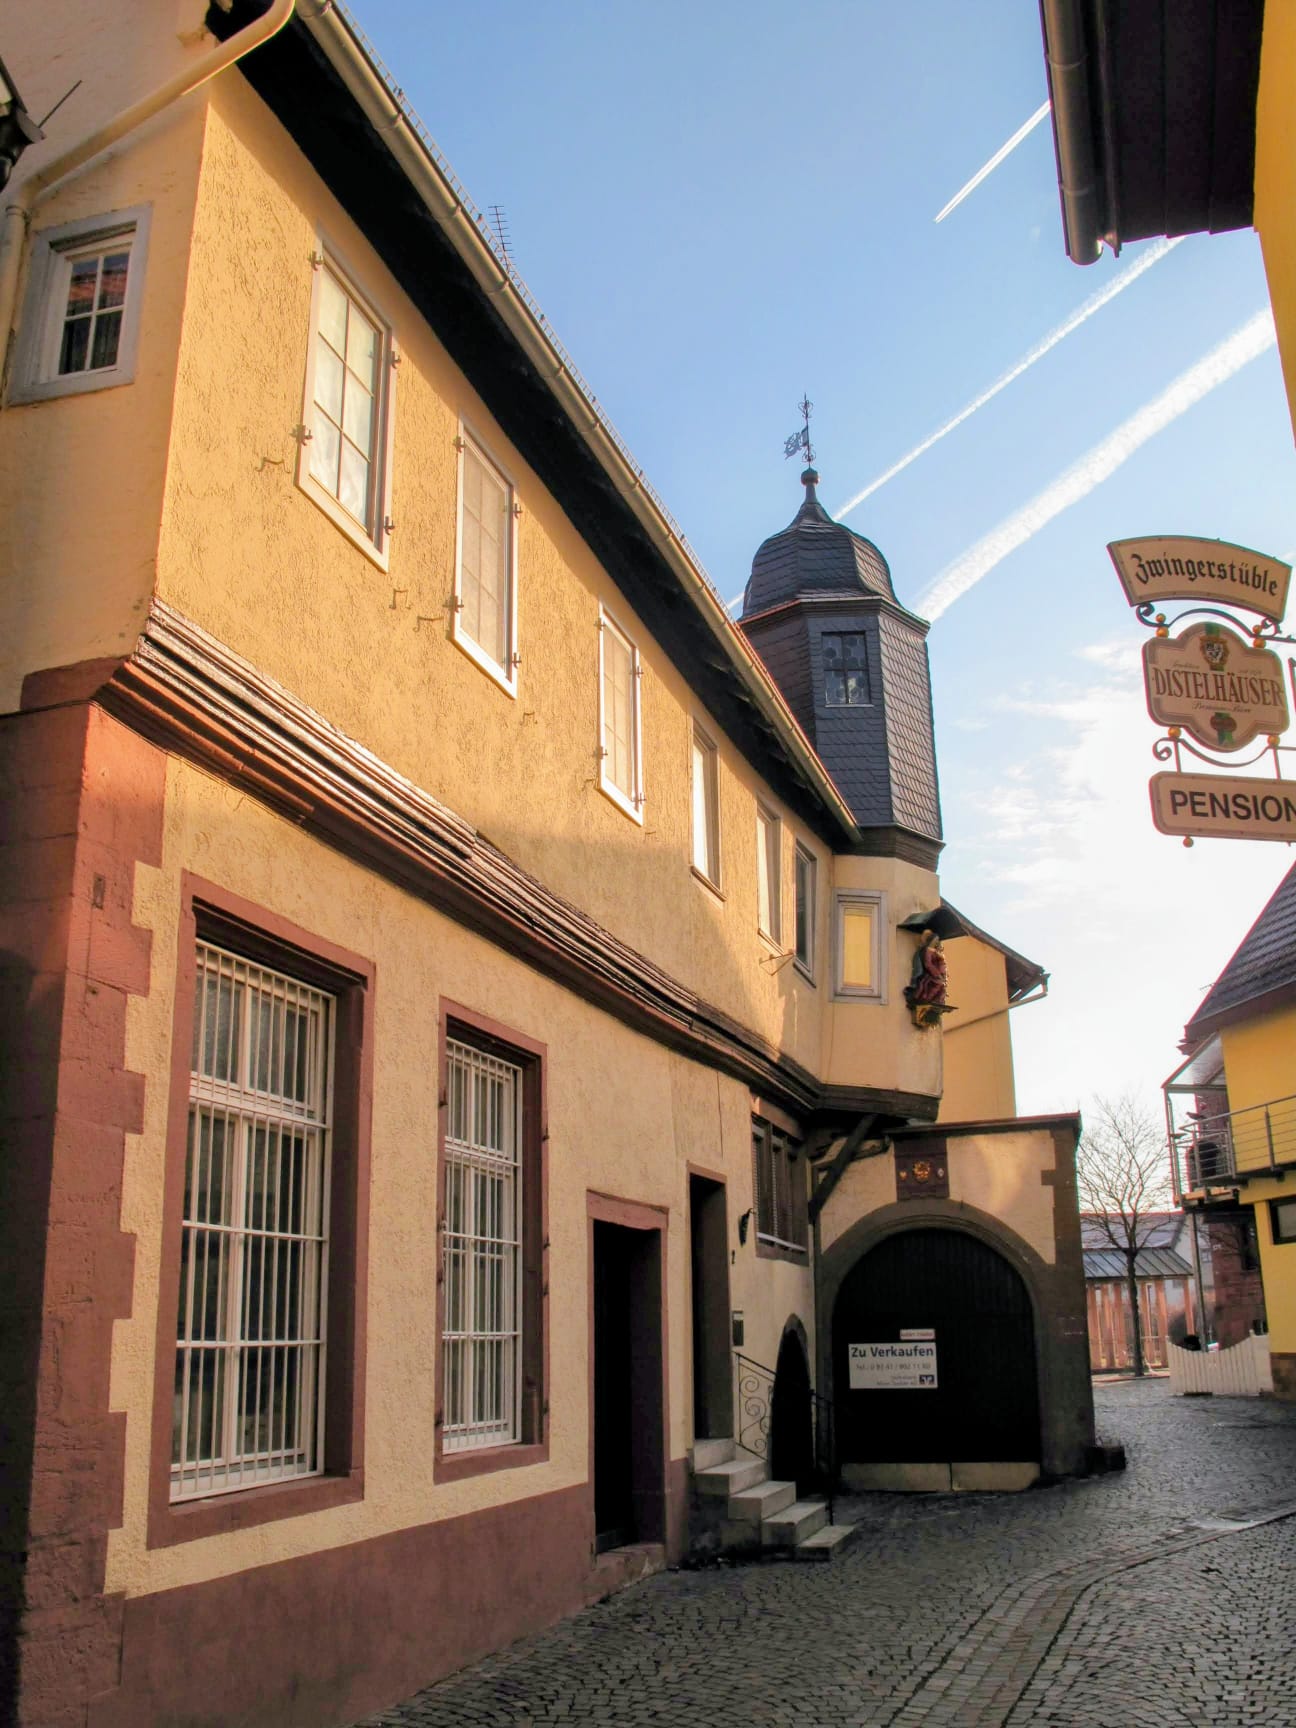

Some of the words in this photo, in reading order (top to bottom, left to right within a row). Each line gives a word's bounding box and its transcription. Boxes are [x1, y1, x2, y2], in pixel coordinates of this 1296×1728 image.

[1131, 552, 1279, 597] Zwingerstüble
[1153, 668, 1283, 706] DISTELHÄUSER
[1170, 789, 1296, 822] PENSION
[851, 1346, 866, 1358] Zu
[870, 1345, 933, 1358] Verkaufen
